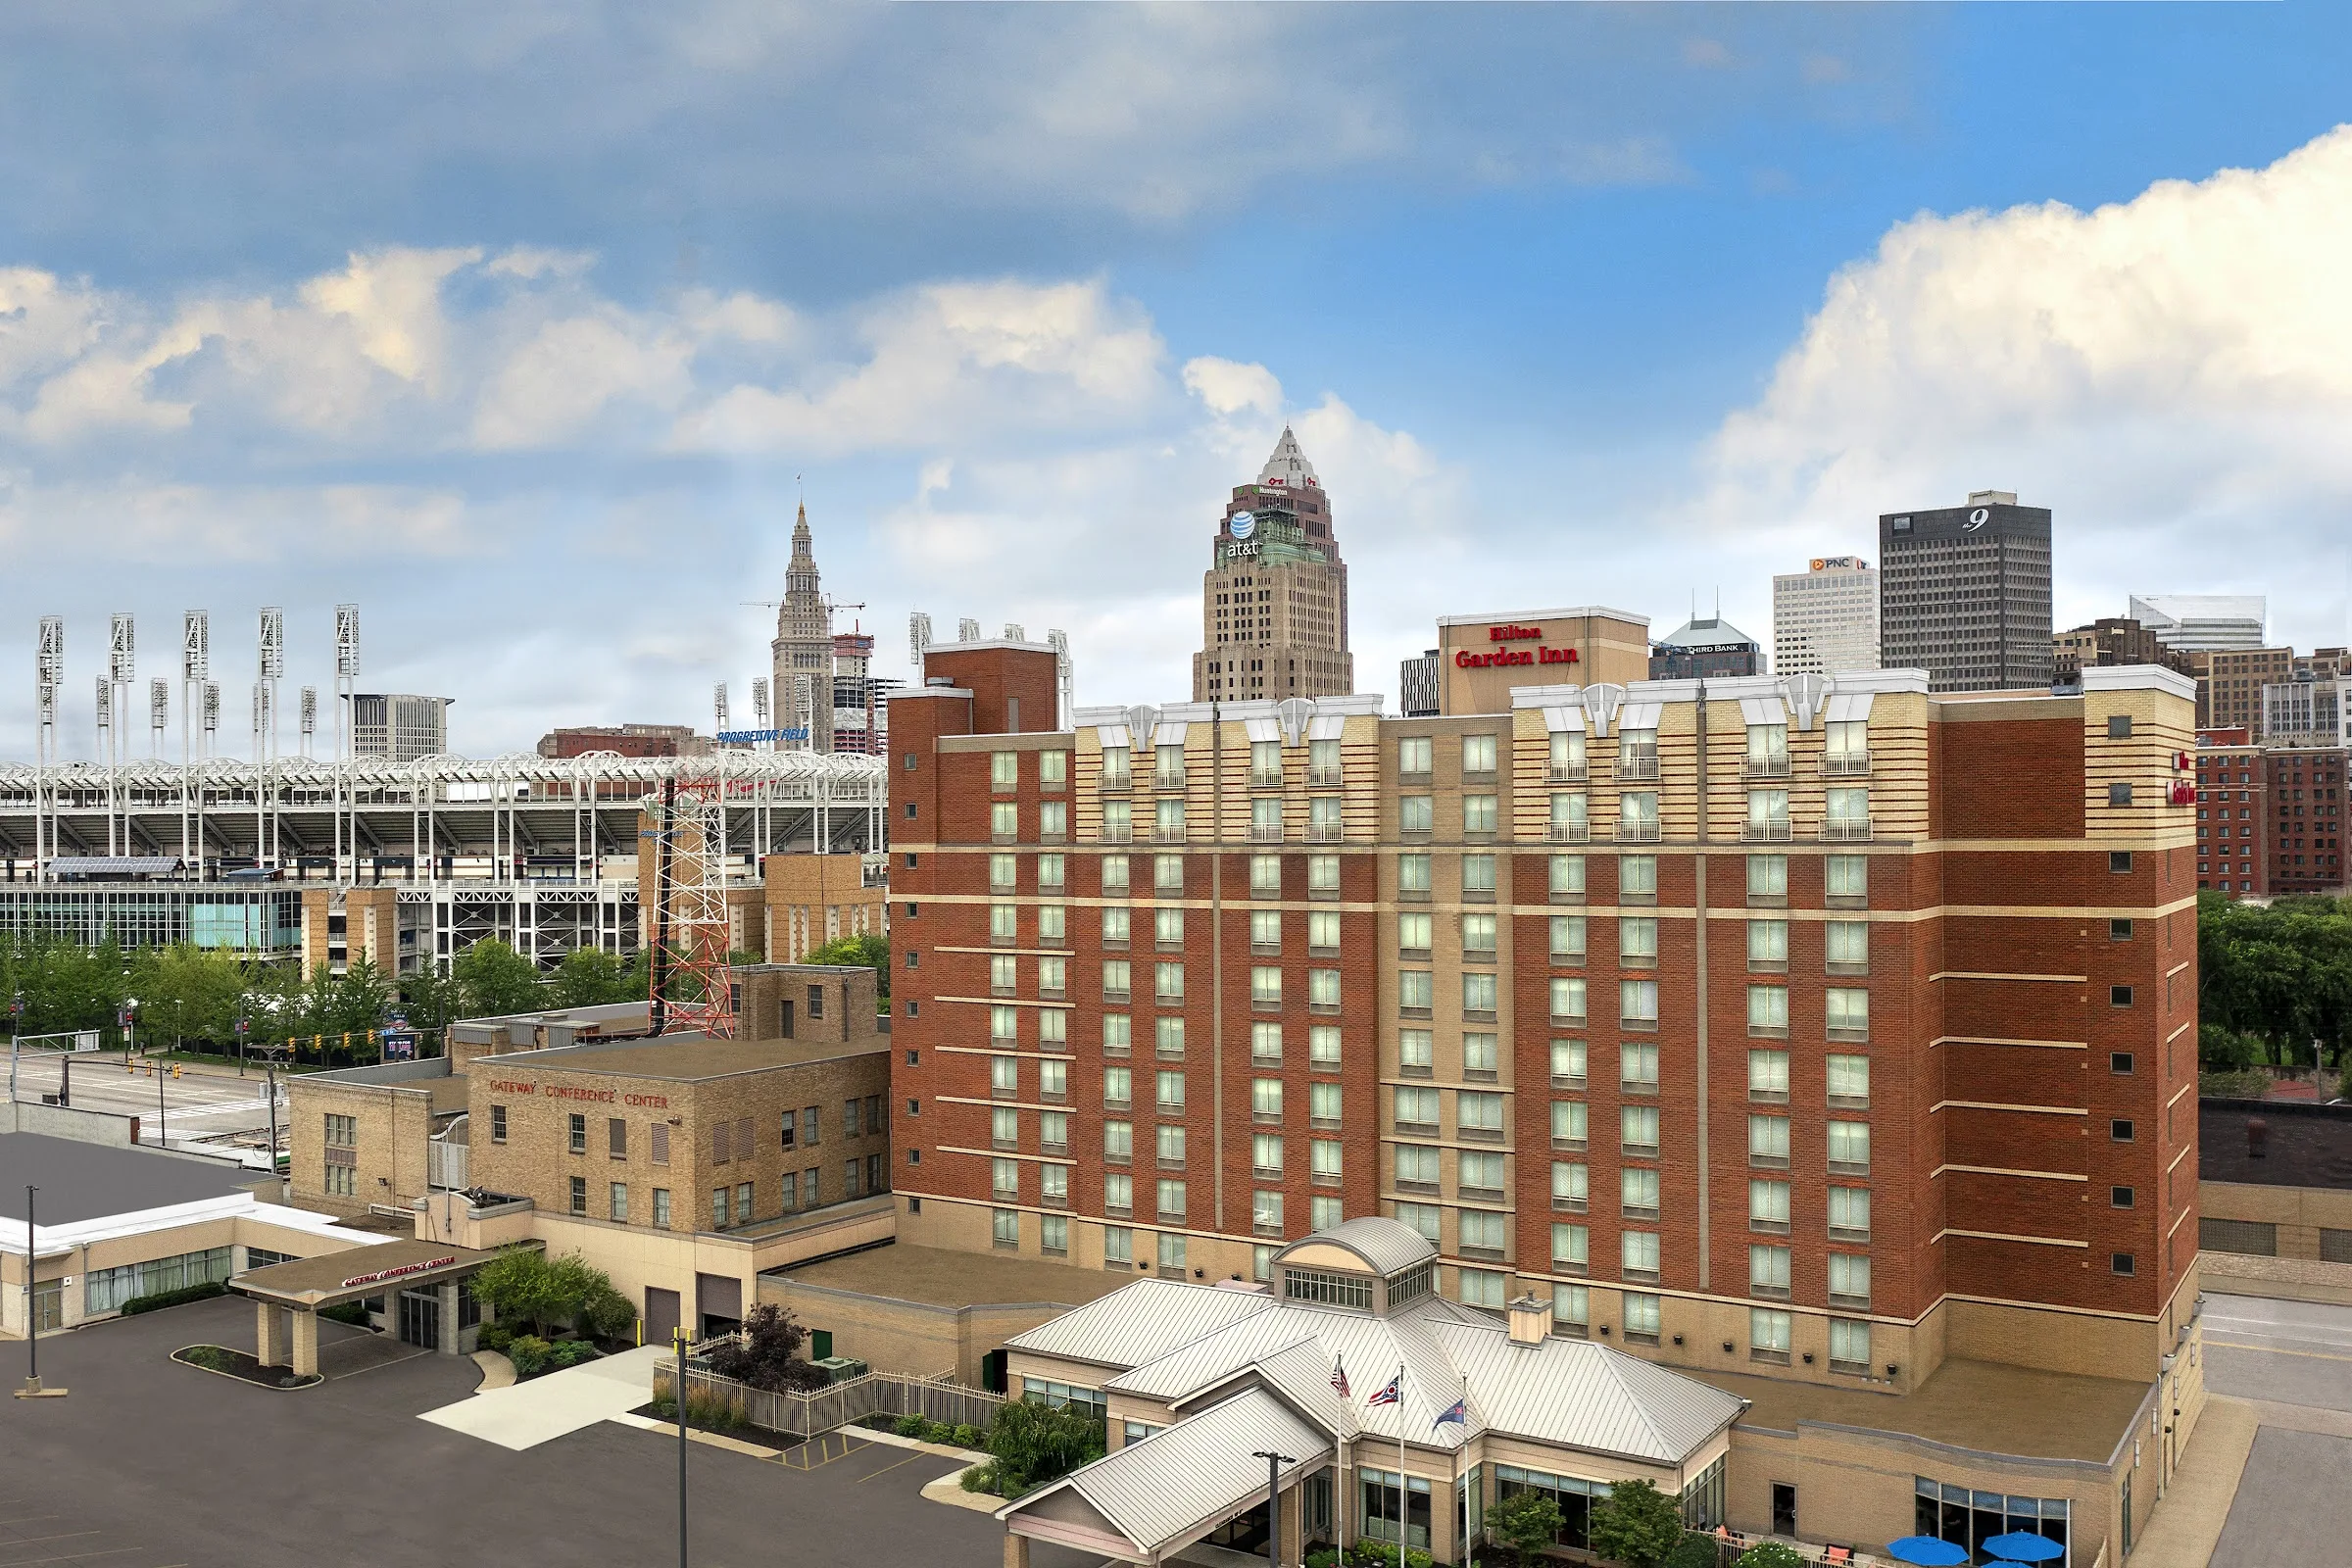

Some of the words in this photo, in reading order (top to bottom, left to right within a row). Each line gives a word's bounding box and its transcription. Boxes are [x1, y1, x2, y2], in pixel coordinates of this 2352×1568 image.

[1259, 486, 1288, 497] Huntington
[1968, 509, 1989, 532] 9
[1227, 540, 1258, 557] at&t
[1825, 559, 1849, 568] PNC
[1490, 625, 1543, 641] Hilton
[1455, 647, 1534, 668] Garden
[1538, 646, 1579, 663] Inn
[716, 729, 780, 743] PROGRESSIVE
[780, 728, 809, 741] FIELD
[490, 1080, 536, 1094] GATEWAY
[545, 1085, 614, 1103] CONFERENCE
[624, 1094, 668, 1109] CENTER
[342, 1272, 378, 1287] GATEWAY
